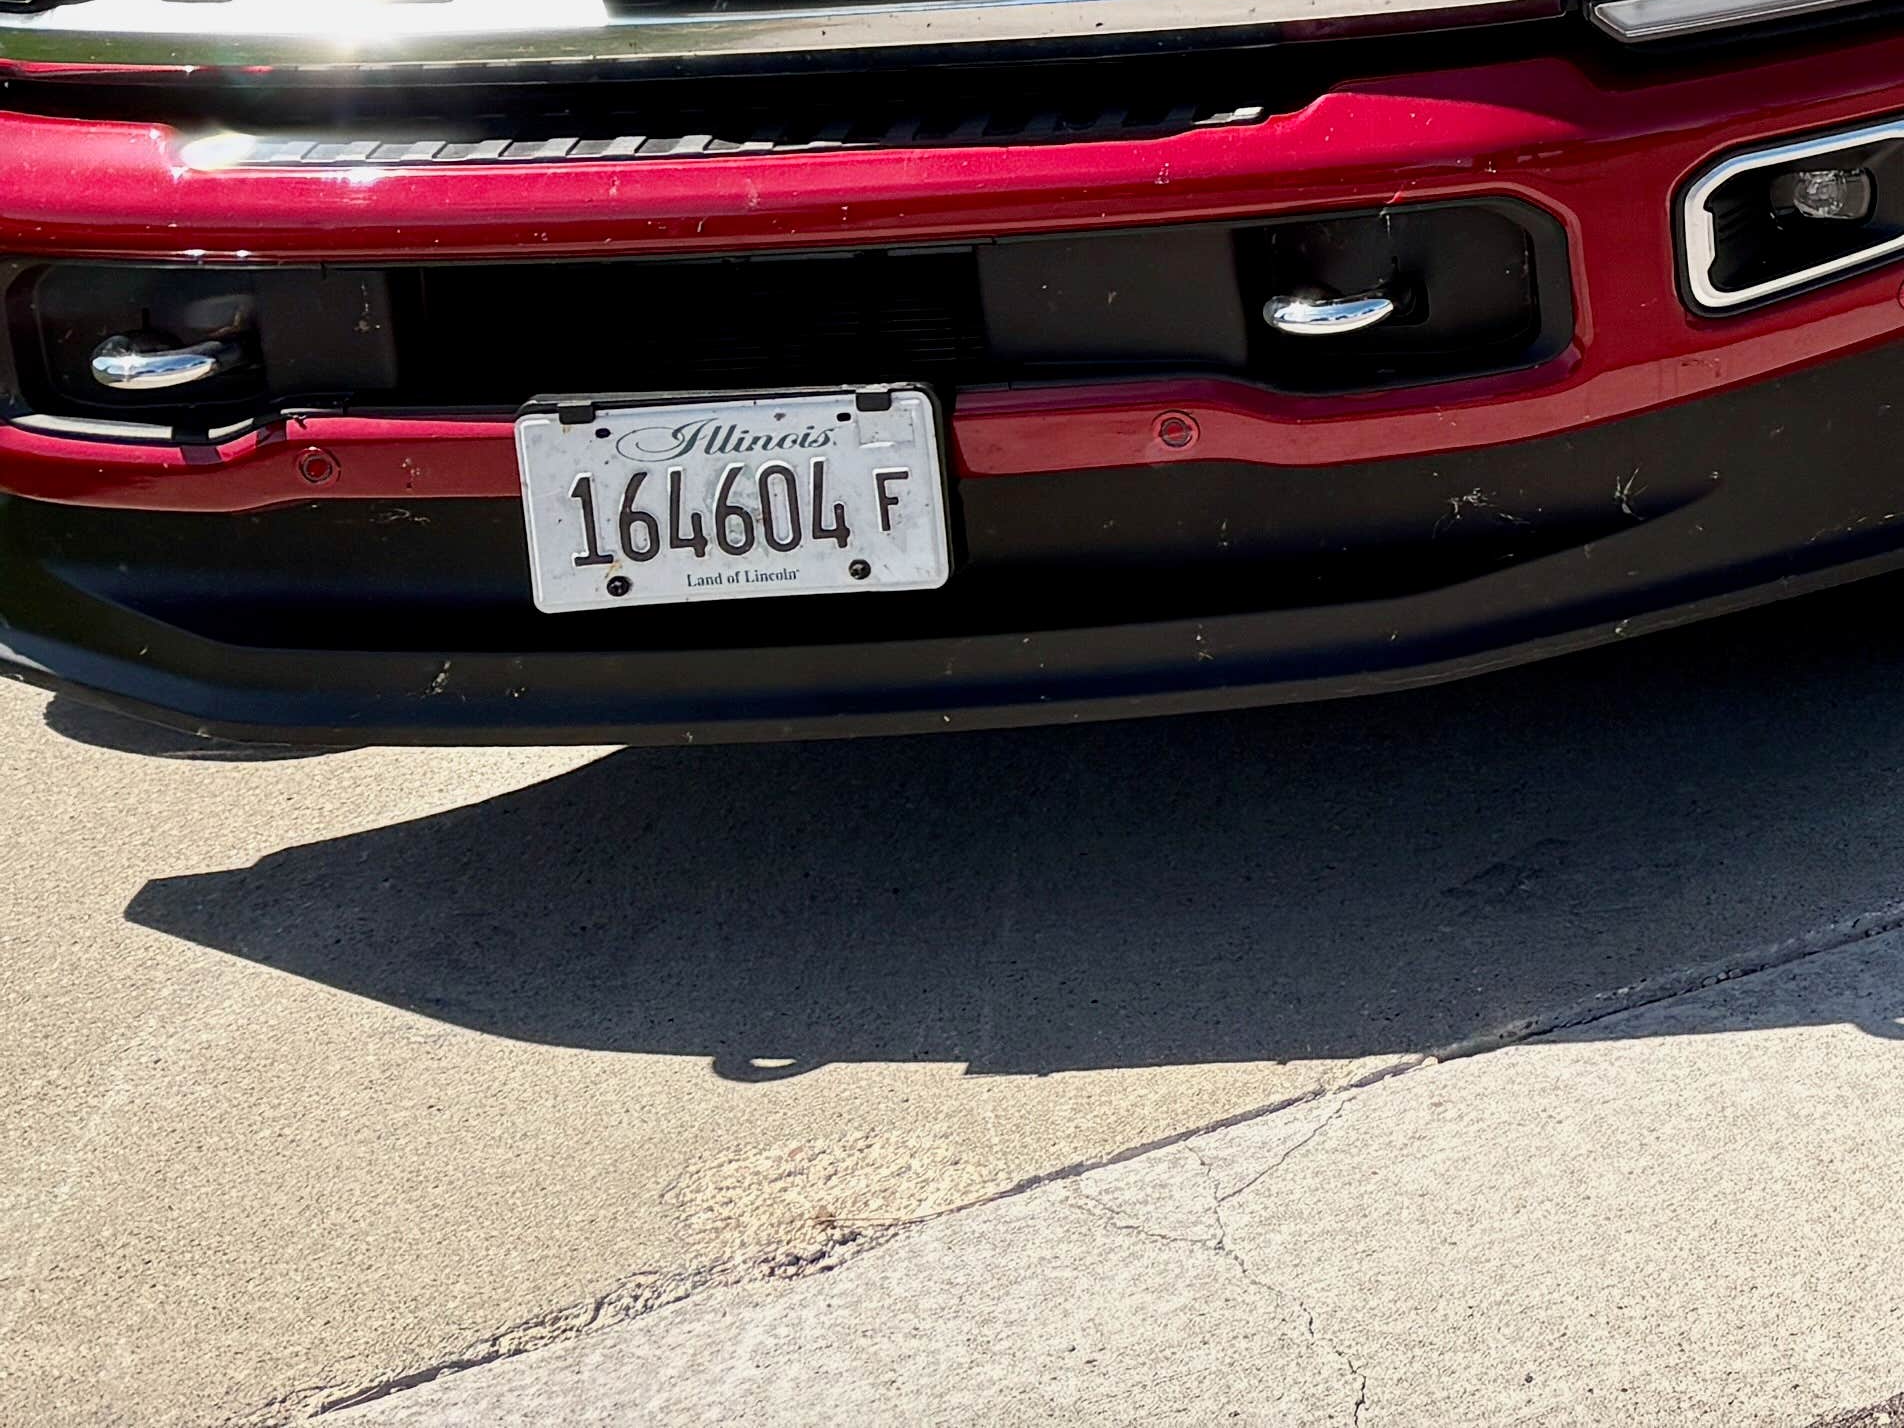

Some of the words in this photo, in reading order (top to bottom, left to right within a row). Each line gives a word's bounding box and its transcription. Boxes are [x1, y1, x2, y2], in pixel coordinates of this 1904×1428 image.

[615, 417, 838, 462] Illinois
[569, 458, 852, 568] 164604
[874, 468, 910, 533] F
[687, 572, 723, 587] Land
[727, 570, 741, 584] of
[744, 568, 798, 584] Lincoln
